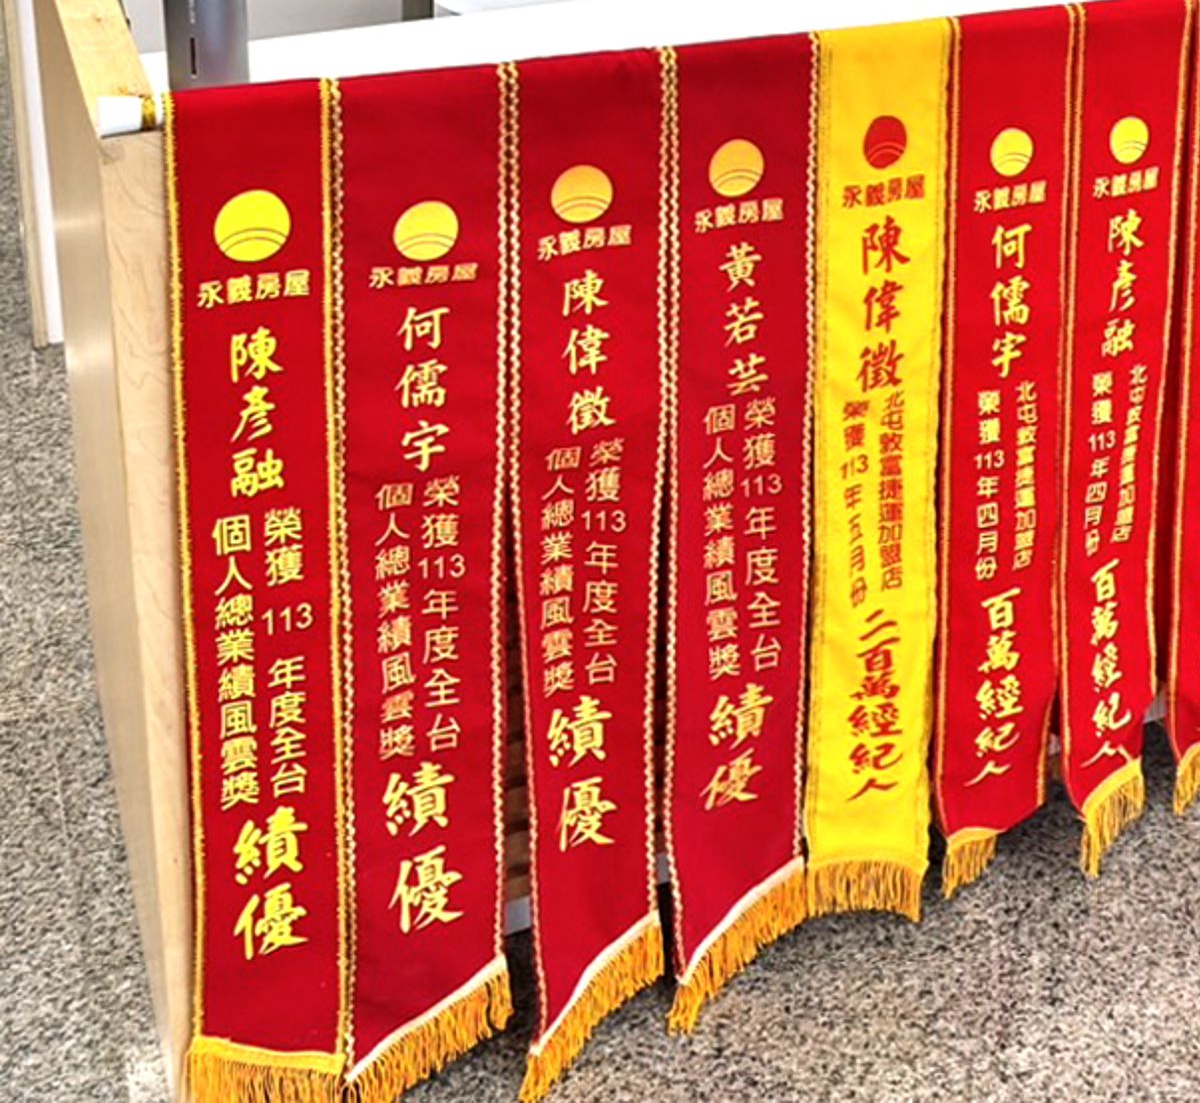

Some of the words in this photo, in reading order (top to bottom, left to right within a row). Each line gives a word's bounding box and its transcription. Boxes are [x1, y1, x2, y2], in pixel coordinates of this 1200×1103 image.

[538, 224, 632, 261] 永義房屋
[694, 198, 783, 233] 永義房屋
[843, 175, 925, 208] 永義房屋
[974, 180, 1047, 214] 永義房屋
[1093, 166, 1159, 199] 永義房屋
[197, 269, 310, 309] 永義房屋
[369, 262, 478, 289] 永義房屋
[562, 269, 616, 435] 陳偉徵
[719, 242, 769, 395] 黃若芸
[990, 223, 1032, 378] 何儒宇
[1101, 208, 1144, 357] 陳彥融
[230, 326, 285, 498] 陳彥融
[395, 306, 450, 472] 何儒宇
[211, 514, 260, 811] 個人總業績風雲獎
[846, 608, 904, 801] 二百萬經紀人
[964, 587, 1024, 787] 百萬經紀人
[1080, 558, 1132, 768] 百萬經紀人
[547, 695, 617, 852] 績優
[701, 683, 774, 810] 績優
[233, 805, 308, 961] 績優
[382, 761, 463, 934] 績優
